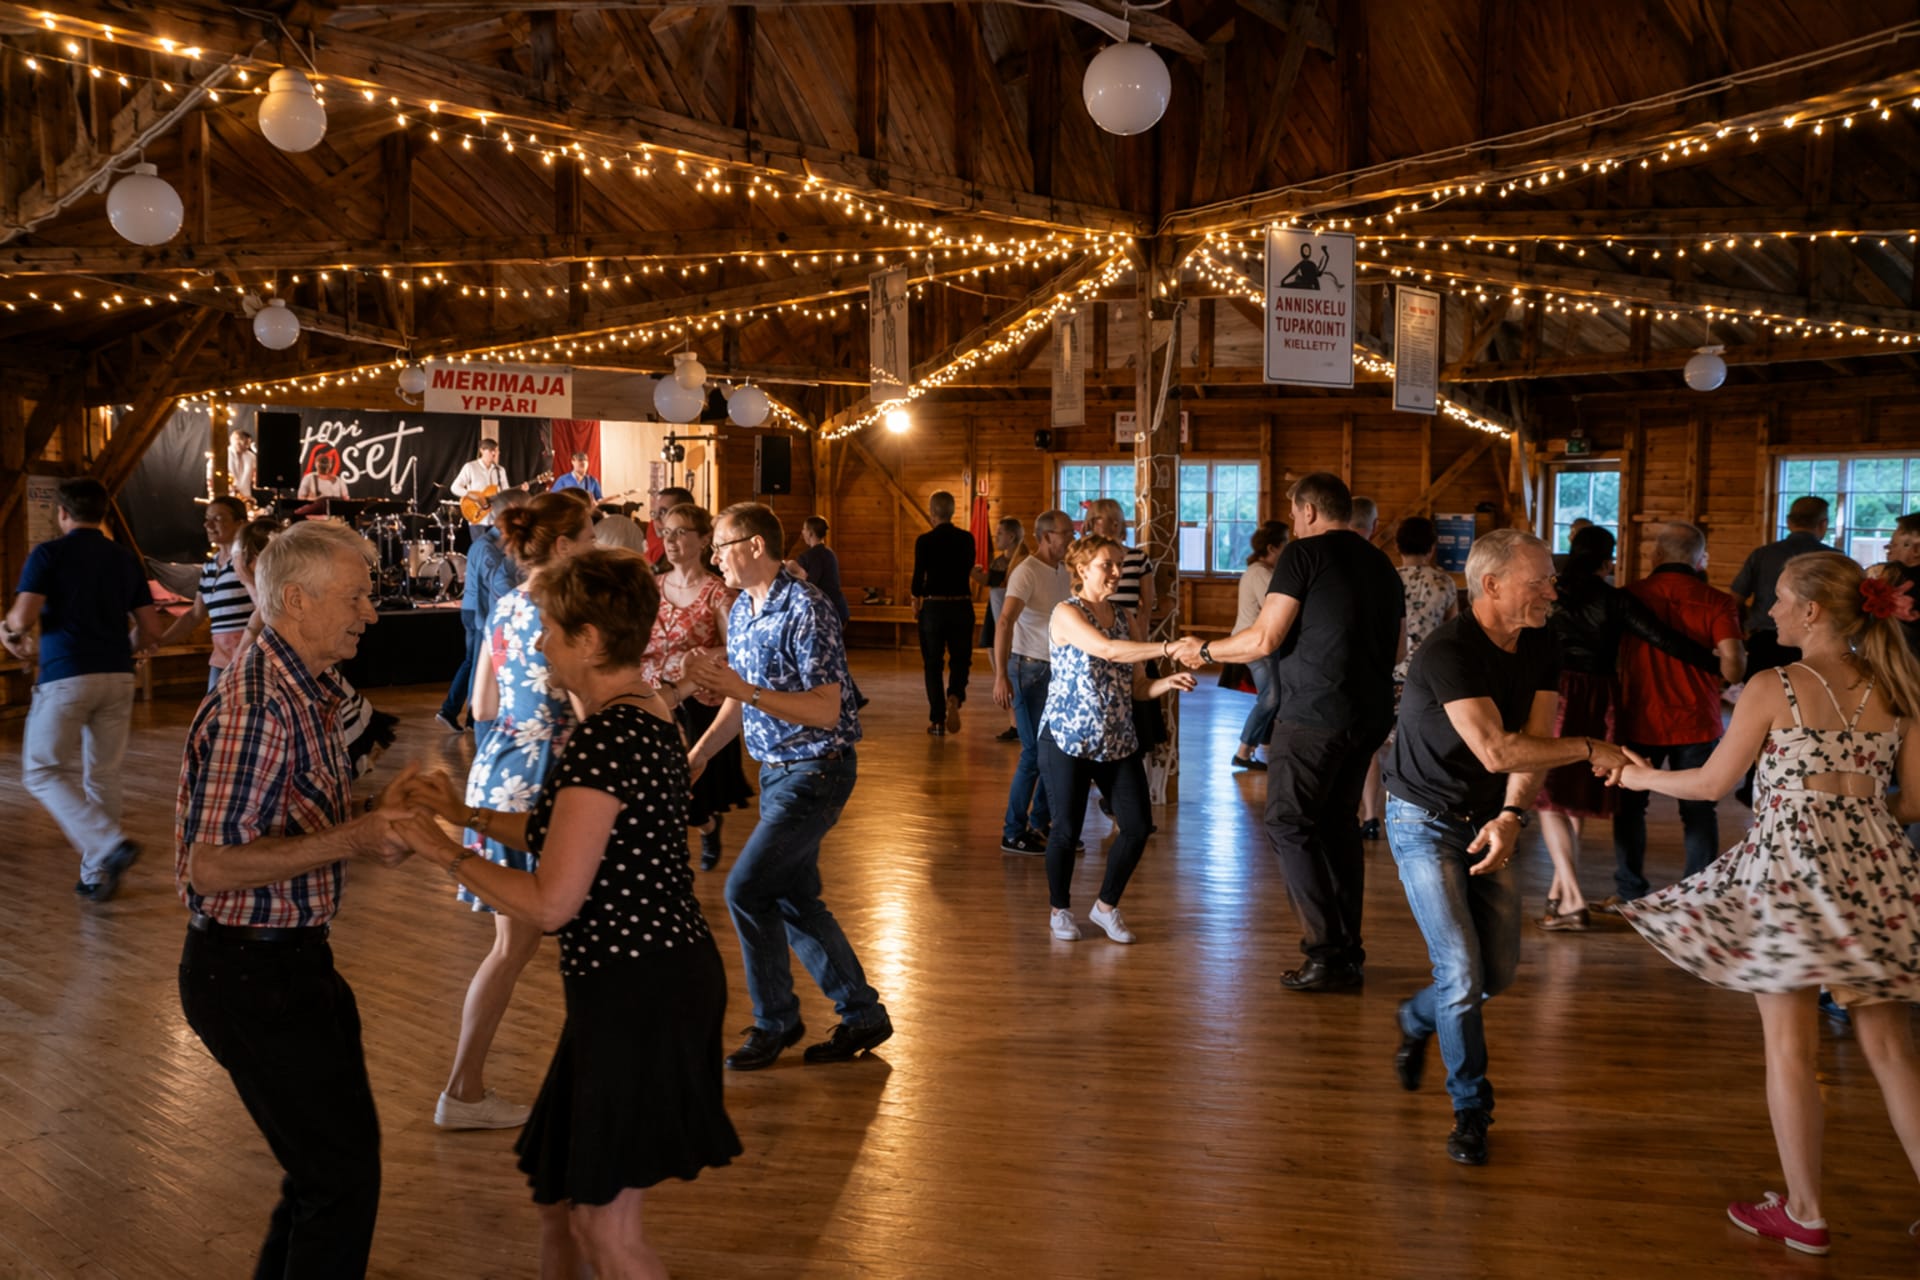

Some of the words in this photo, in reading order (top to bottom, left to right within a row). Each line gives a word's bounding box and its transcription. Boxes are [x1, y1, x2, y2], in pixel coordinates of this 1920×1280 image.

[1275, 295, 1346, 317] ANNISKELU
[1275, 316, 1346, 338] TUPAKOINTI
[1284, 338, 1337, 352] KIELLETTY
[432, 369, 566, 396] MERIMAJA
[461, 394, 537, 414] YPPÄRI
